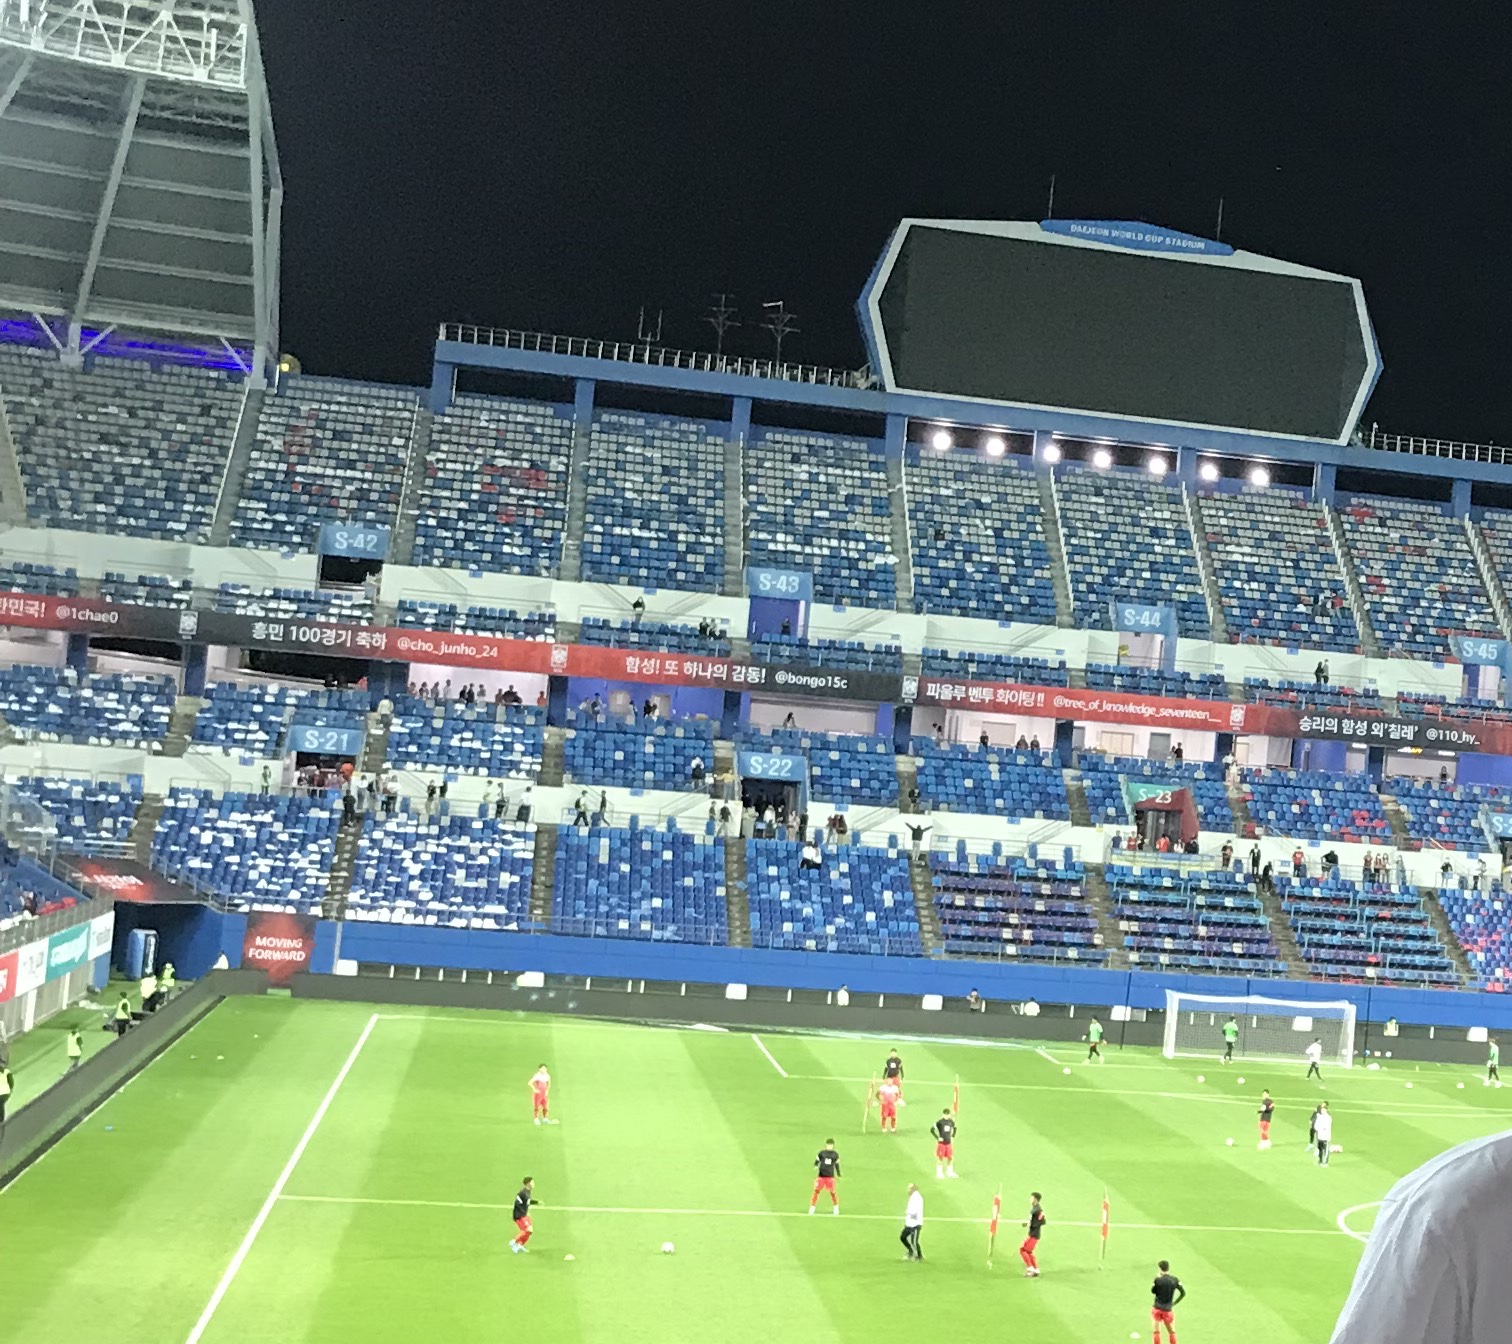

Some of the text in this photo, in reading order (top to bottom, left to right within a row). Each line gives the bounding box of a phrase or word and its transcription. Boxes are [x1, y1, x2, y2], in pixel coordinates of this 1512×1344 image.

[1070, 223, 1206, 250] DAEJEON WORLD CUP STADIUM
[334, 530, 378, 552] S-42
[759, 575, 800, 594] S-43
[1123, 608, 1161, 629] S-44
[290, 625, 352, 648] 100경기
[356, 631, 387, 651] 축하
[397, 636, 499, 659] @cho_junho_24
[1461, 640, 1498, 661] S-45
[663, 659, 679, 676] 또
[683, 661, 728, 680] 하나의
[732, 665, 766, 684] 감동!
[775, 670, 849, 689] @bongo15c
[926, 682, 966, 701] 파울루
[968, 686, 994, 704] 벤투
[1299, 715, 1338, 734] 승리의
[1341, 718, 1368, 736] 함성
[304, 729, 349, 751] S-21
[749, 755, 791, 777] S-22
[1138, 788, 1172, 805] S-23
[255, 936, 303, 949] MOVING
[248, 947, 306, 962] FORWARD
